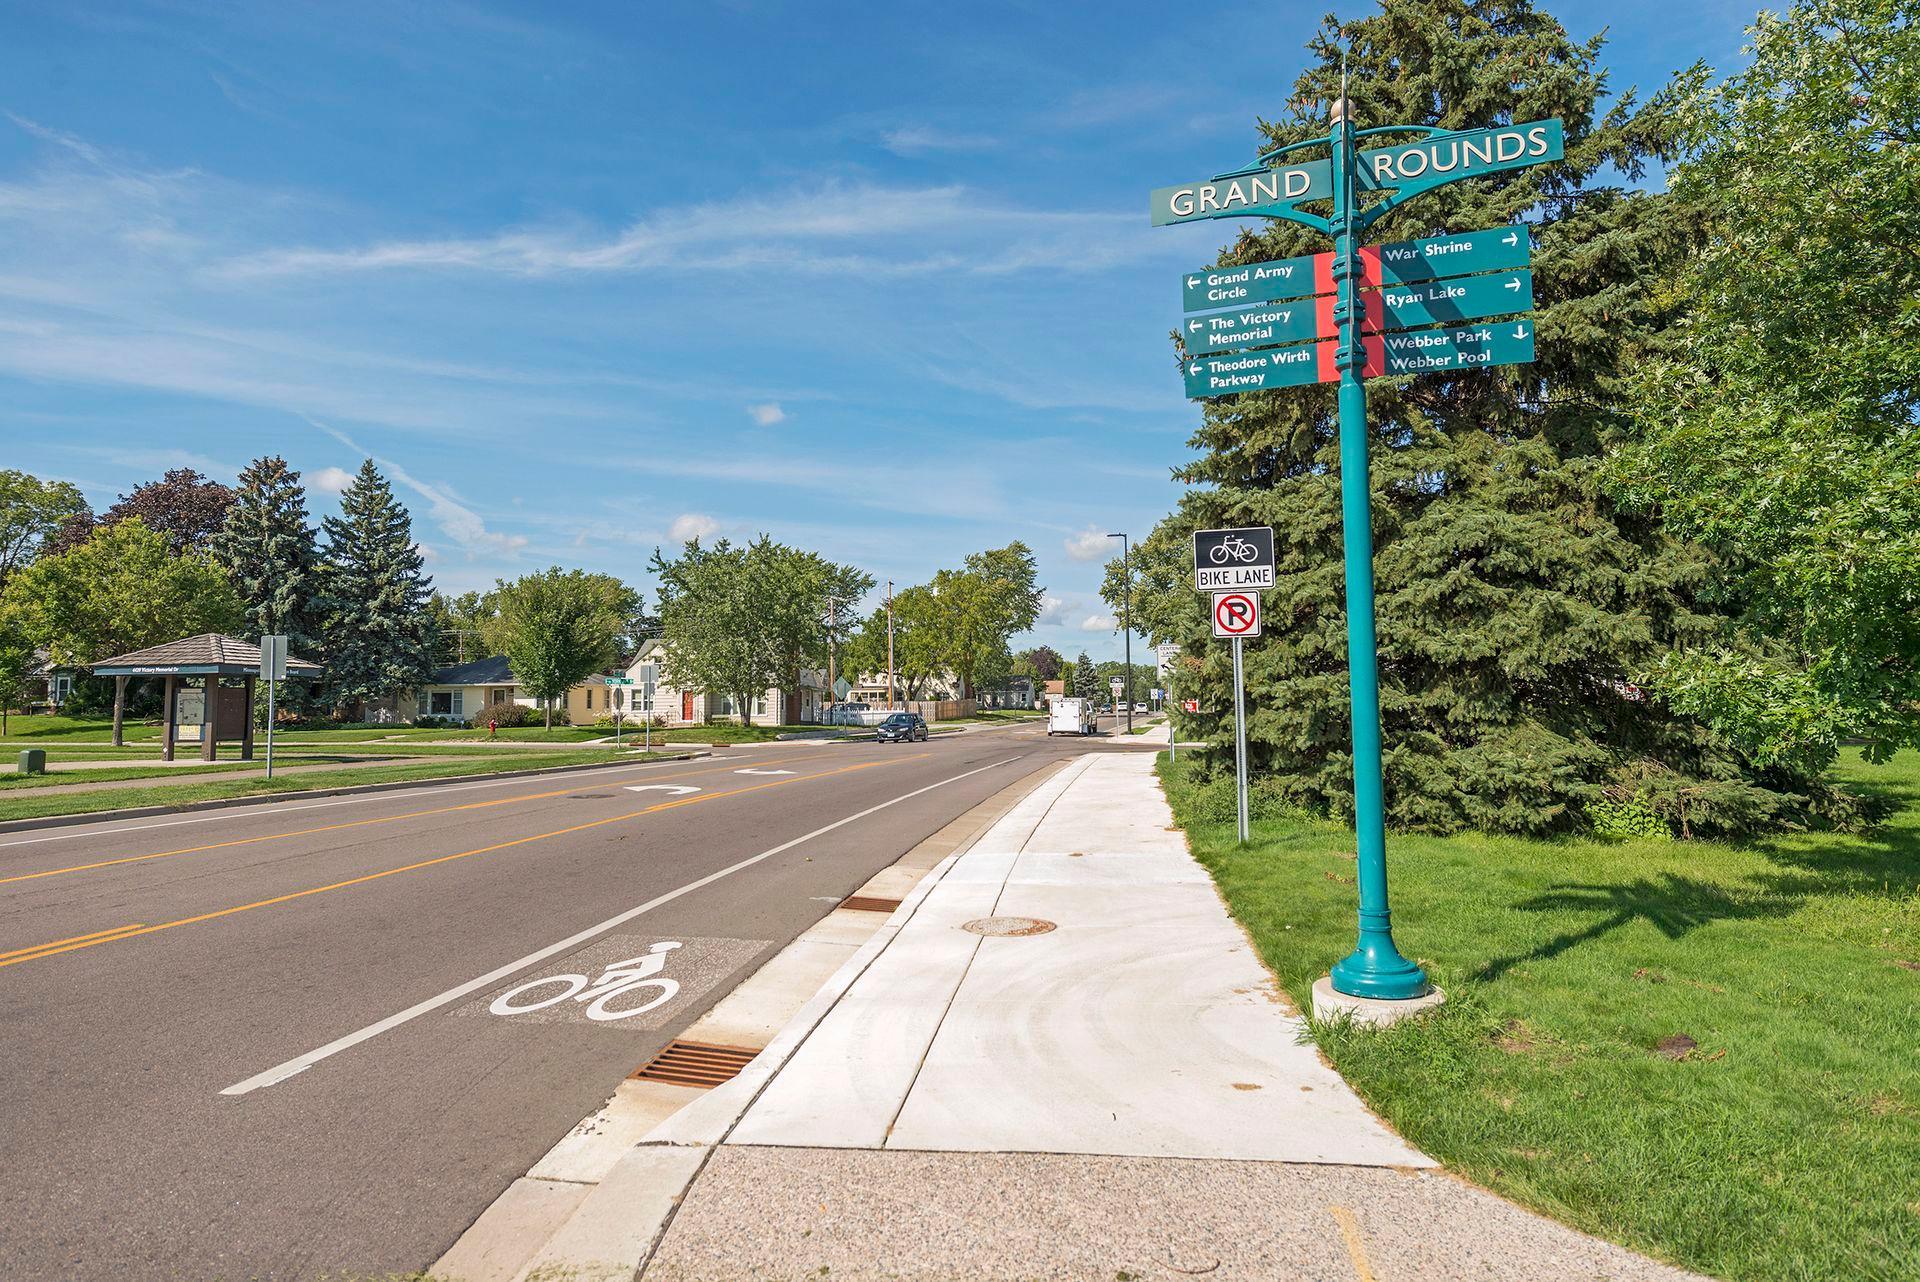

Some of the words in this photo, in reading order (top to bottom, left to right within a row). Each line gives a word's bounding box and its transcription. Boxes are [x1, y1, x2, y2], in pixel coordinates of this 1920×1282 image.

[1170, 170, 1311, 216] GRAND
[1374, 127, 1548, 182] ROUNDS
[1385, 248, 1419, 261] War
[1425, 241, 1473, 256] Shrine
[1207, 270, 1249, 286] Grand
[1254, 266, 1294, 280] Army
[1207, 286, 1247, 301] Circle
[1386, 293, 1423, 308] Ryan
[1429, 286, 1466, 300] Lake
[1208, 317, 1235, 330] The
[1240, 310, 1292, 326] Victory
[1209, 326, 1272, 346] Memorial
[1389, 335, 1450, 350] Webber
[1456, 329, 1492, 343] Park
[1208, 357, 1267, 373] Theodore
[1271, 350, 1311, 365] Wirth
[1391, 355, 1452, 370] Webber
[1457, 349, 1491, 364] Pool
[1210, 373, 1265, 389] Parkway
[1200, 571, 1230, 586] BIKE
[1235, 569, 1271, 584] LANE
